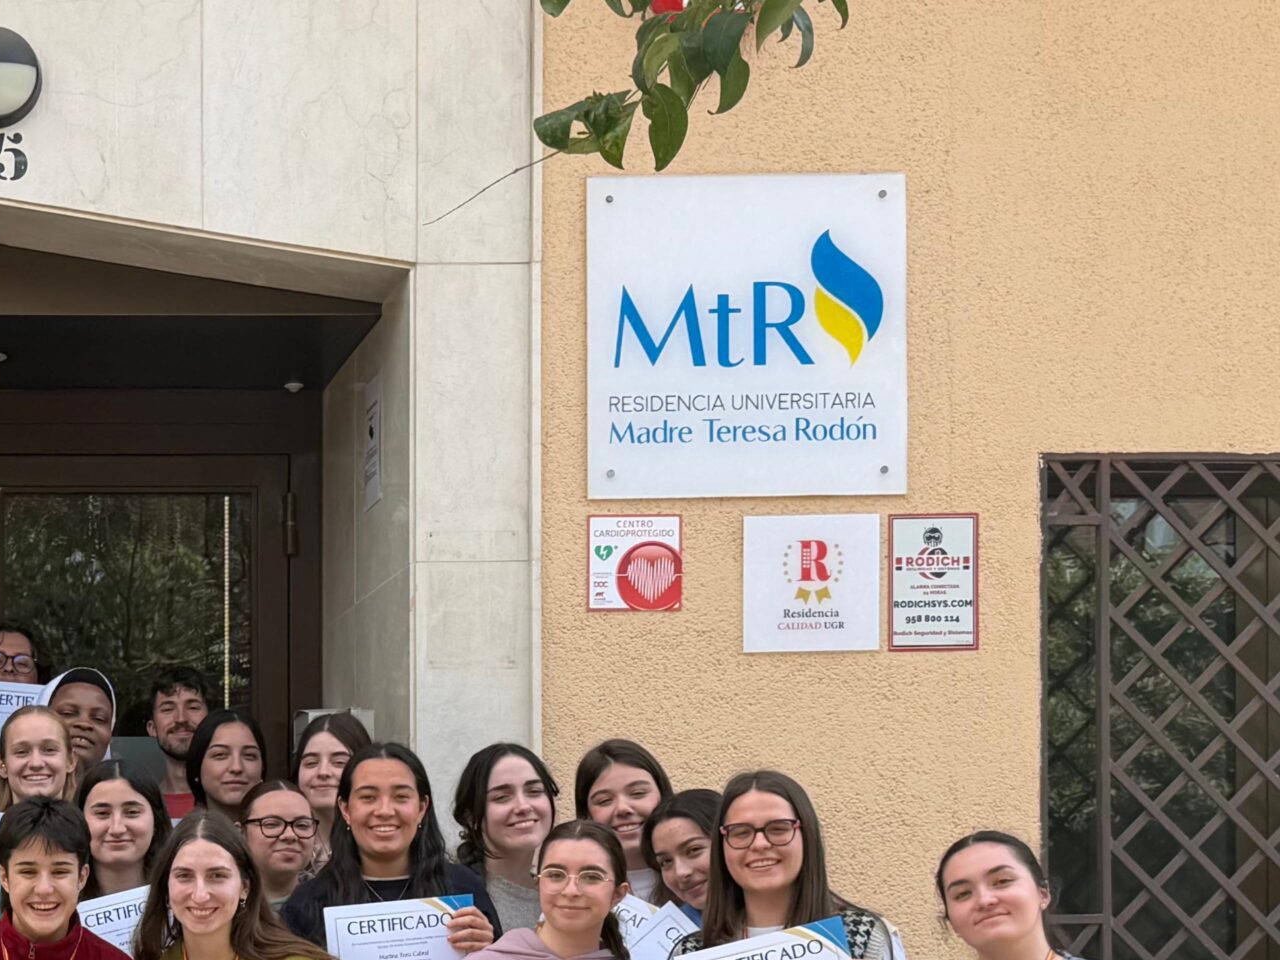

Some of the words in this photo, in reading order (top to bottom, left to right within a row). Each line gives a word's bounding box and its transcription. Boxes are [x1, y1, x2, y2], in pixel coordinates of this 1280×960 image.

[613, 281, 815, 368] MtR
[608, 394, 725, 412] RESIDENCIA
[731, 392, 875, 411] UNIVERSITARIA
[609, 419, 694, 444] Madre
[702, 418, 786, 443] Teresa
[794, 415, 877, 441] Rodón
[616, 520, 653, 528] CENTRO
[593, 529, 675, 537] CARDIOPROTEGIDO
[906, 556, 960, 567] RODICH
[893, 599, 973, 609] RODICHSYS.COM
[783, 608, 840, 618] Residencia
[905, 615, 922, 624] 958
[924, 615, 942, 623] 800
[777, 622, 822, 631] CALIDAD
[823, 621, 845, 630] UGR
